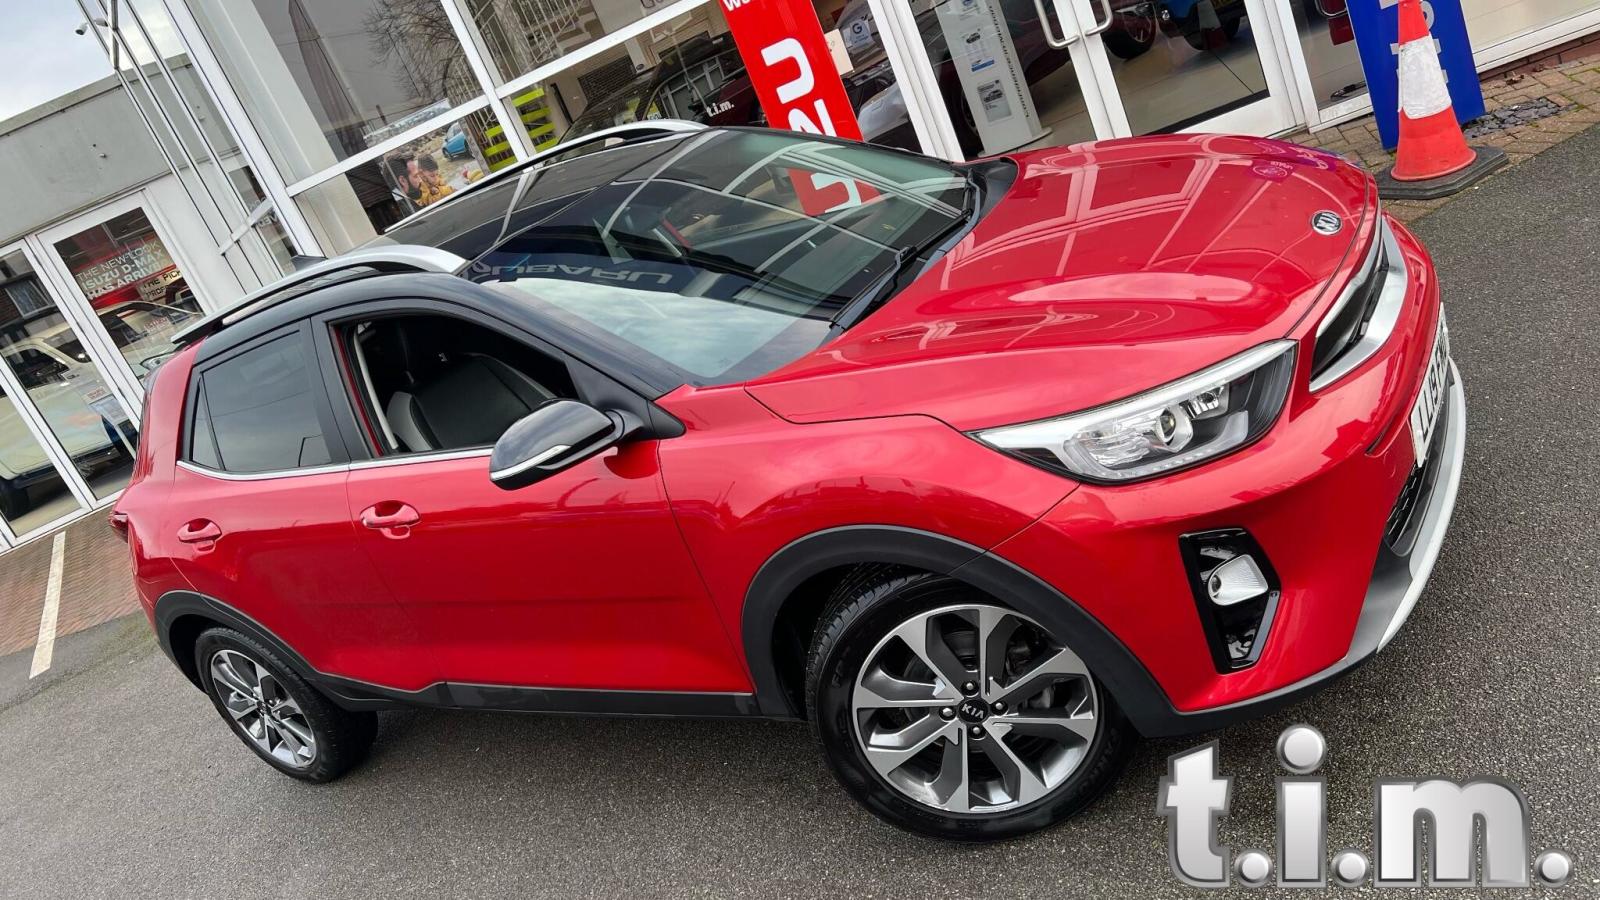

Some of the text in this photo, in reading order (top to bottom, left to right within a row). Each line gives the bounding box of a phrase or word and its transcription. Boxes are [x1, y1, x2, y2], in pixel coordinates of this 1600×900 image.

[75, 266, 99, 281] THE
[81, 249, 165, 290] ISUZU D-MAX
[962, 703, 984, 719] KIA
